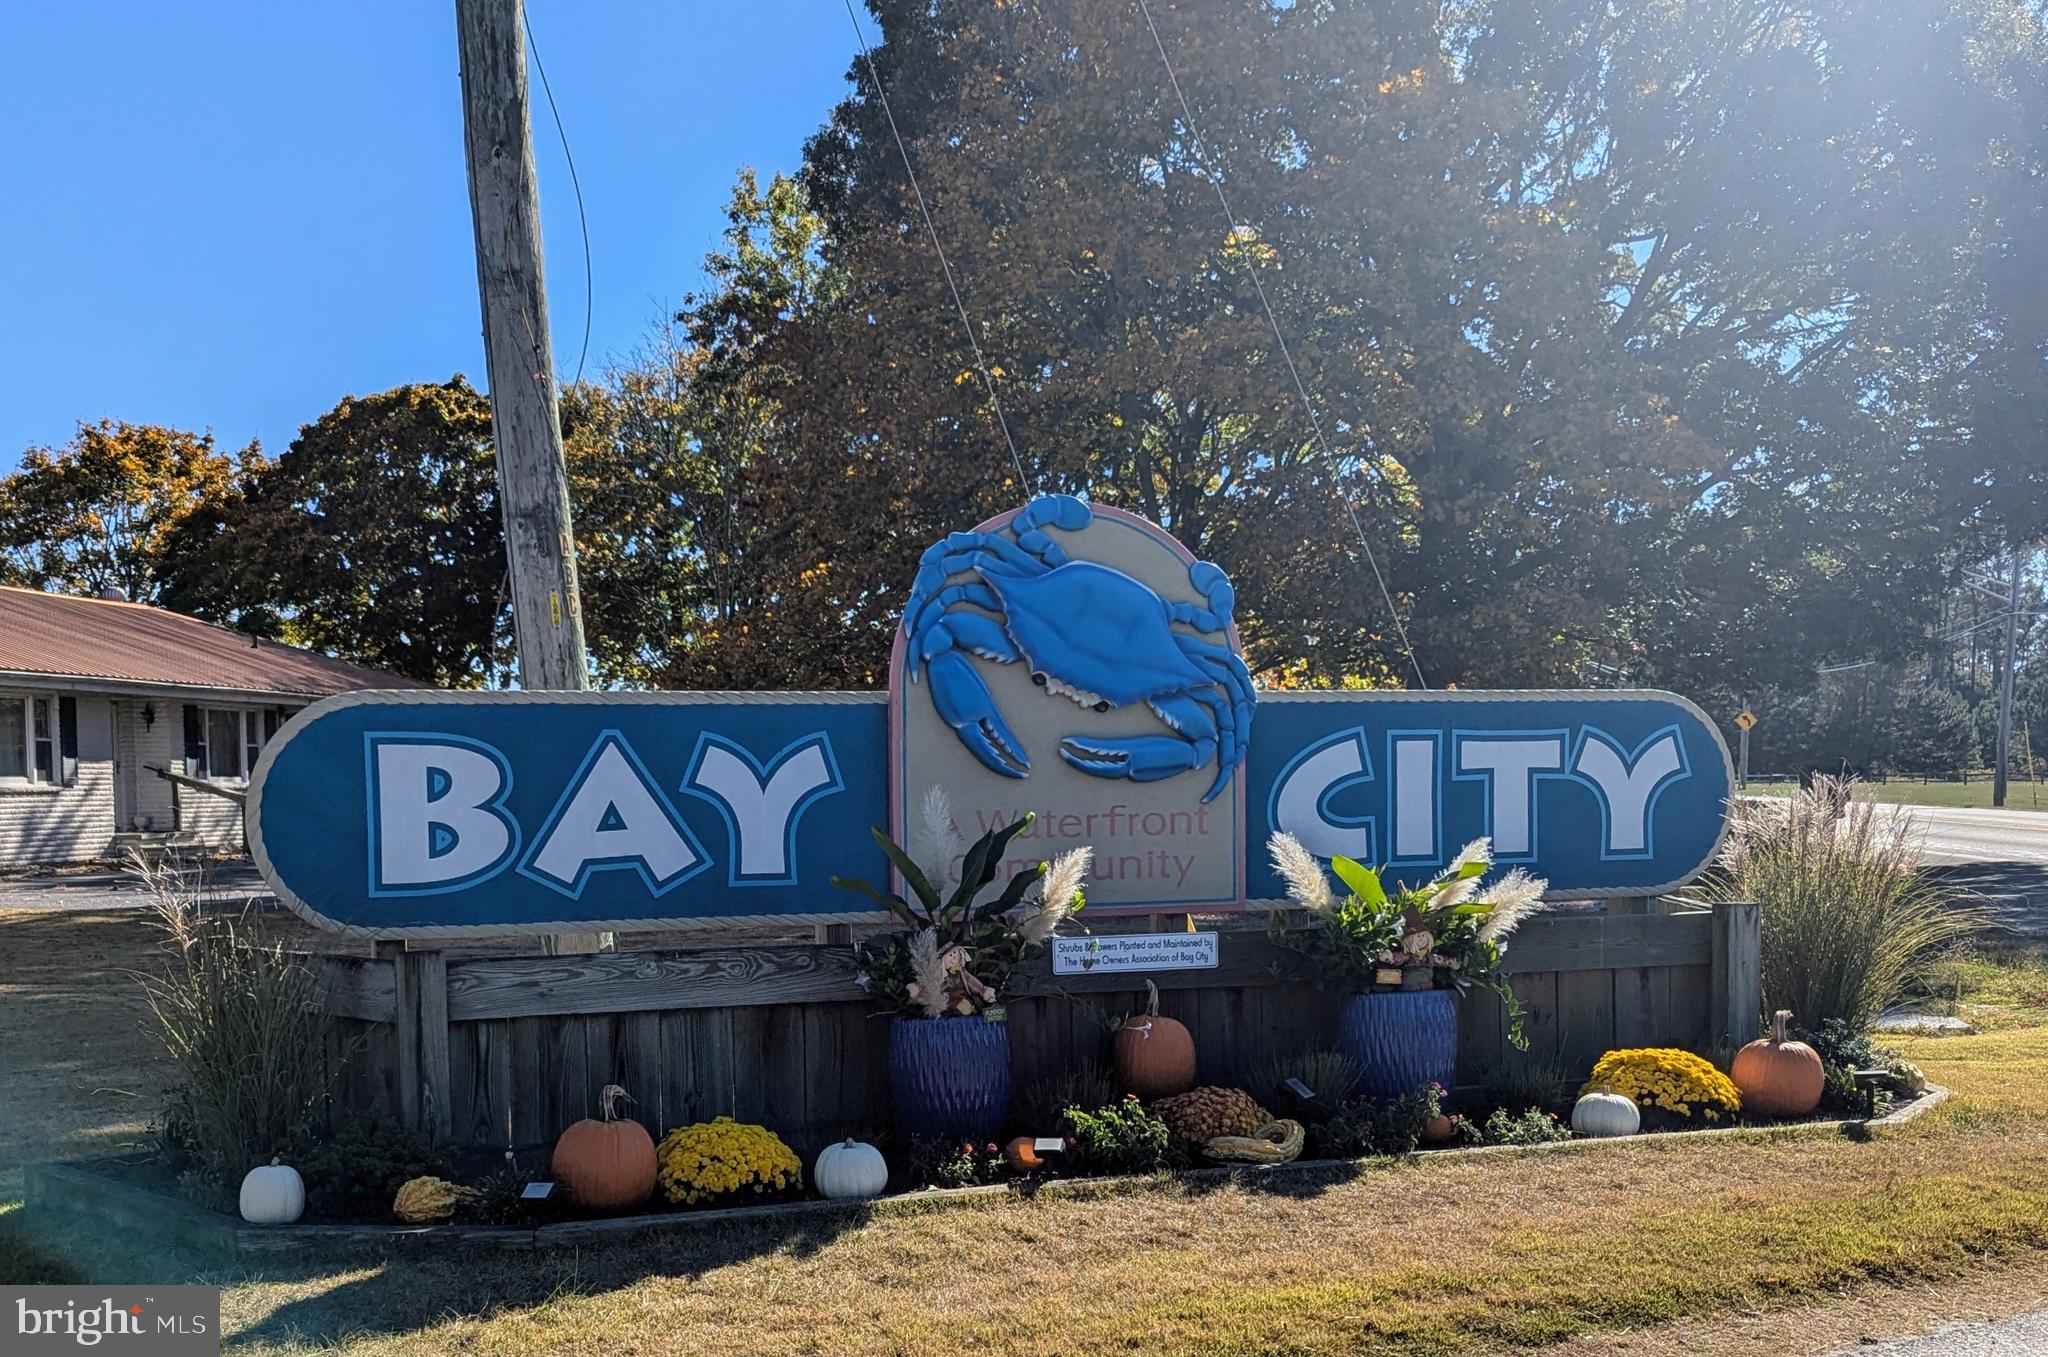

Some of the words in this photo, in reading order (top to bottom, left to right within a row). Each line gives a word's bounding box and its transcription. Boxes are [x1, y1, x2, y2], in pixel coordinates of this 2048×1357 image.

[364, 729, 845, 900] BAY
[1267, 724, 1692, 868] CITY
[949, 850, 1196, 887] Cmunity
[1058, 942, 1083, 953] Shrubs
[1084, 942, 1090, 952] &
[1091, 941, 1117, 952] owers
[1119, 940, 1146, 951] Planted
[1147, 939, 1162, 949] and
[1163, 938, 1203, 949] Maintained
[1204, 937, 1214, 950] by
[1064, 956, 1078, 966] The
[1102, 954, 1130, 965] Owners
[1131, 952, 1170, 963] Association
[1171, 951, 1180, 962] of
[1180, 951, 1194, 963] Bay
[1195, 951, 1209, 963] City
